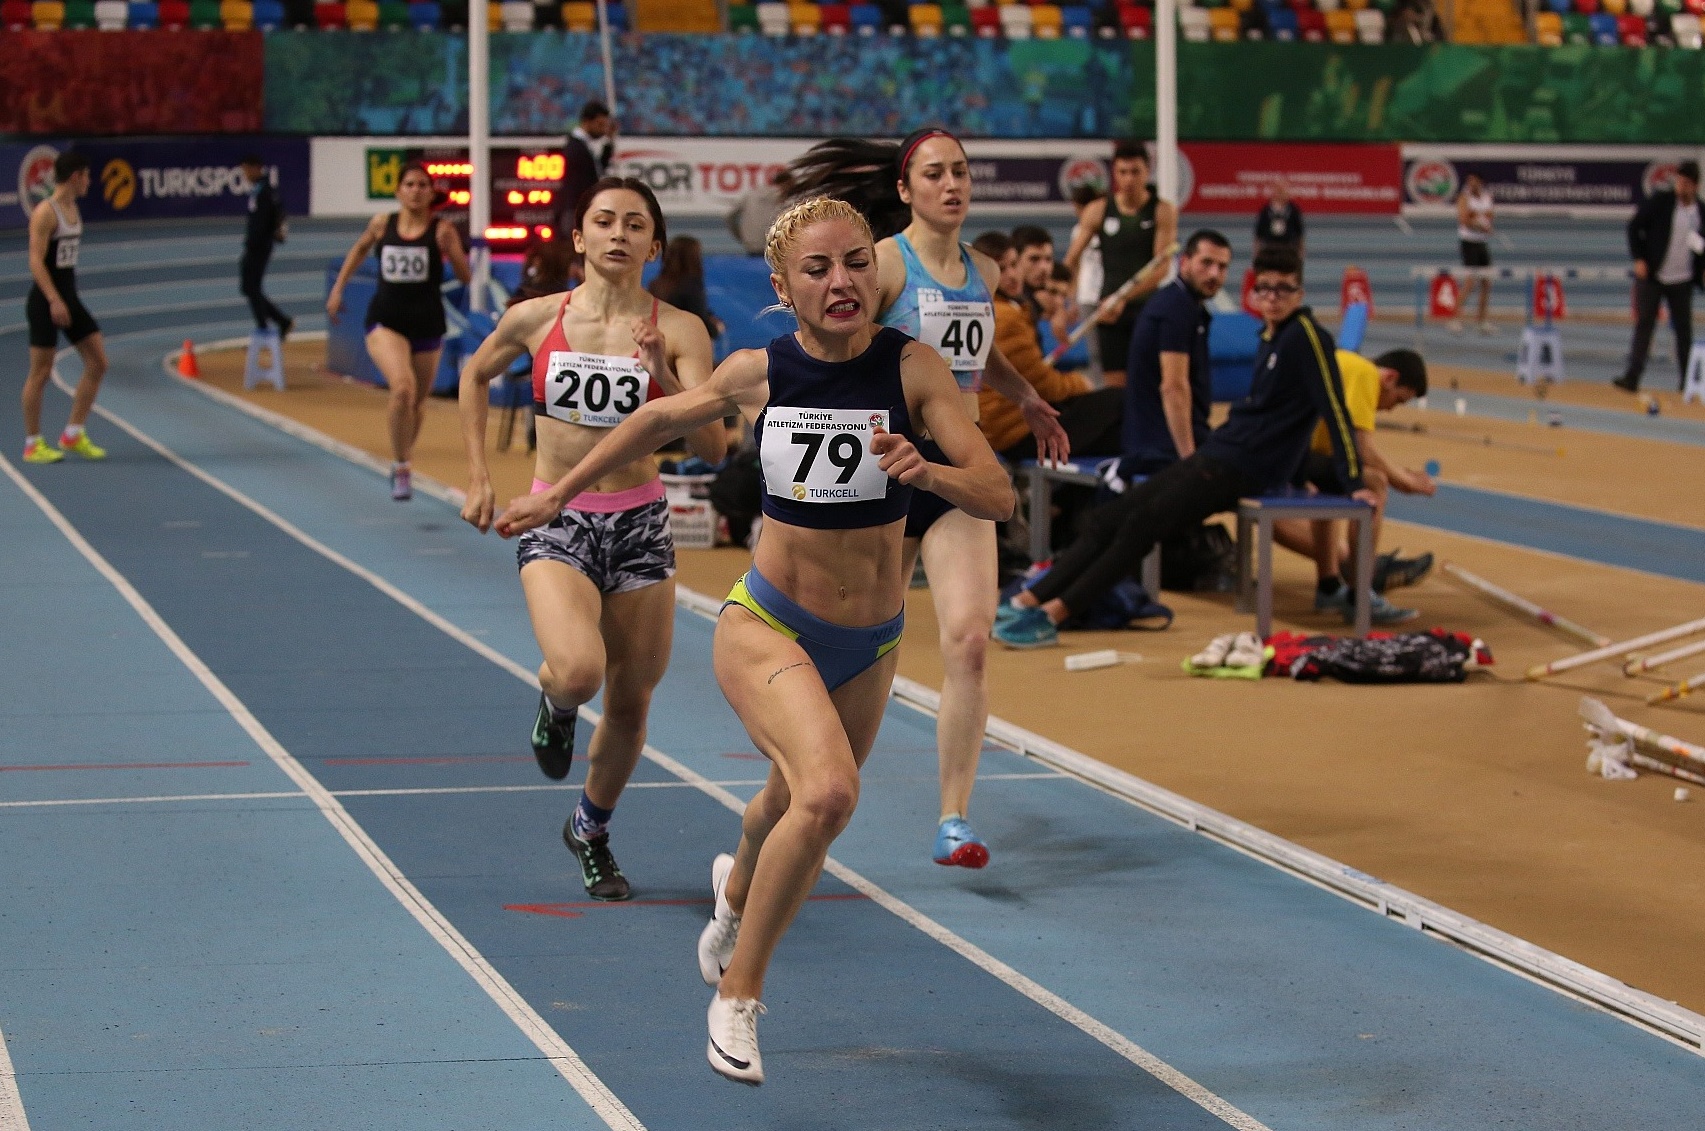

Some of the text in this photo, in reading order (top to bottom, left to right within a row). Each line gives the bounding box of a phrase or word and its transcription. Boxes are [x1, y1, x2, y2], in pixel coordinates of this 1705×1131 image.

[384, 254, 427, 275] 320
[941, 319, 984, 357] 40
[579, 356, 606, 364] TÜRKİYE
[553, 369, 641, 415] 203
[583, 413, 621, 424] TURKCELL
[798, 411, 834, 421] TÜRKİYE
[767, 419, 868, 431] ATLETİZM FEDERASYONU
[790, 431, 864, 485] 79
[809, 488, 860, 498] TURKCELL
